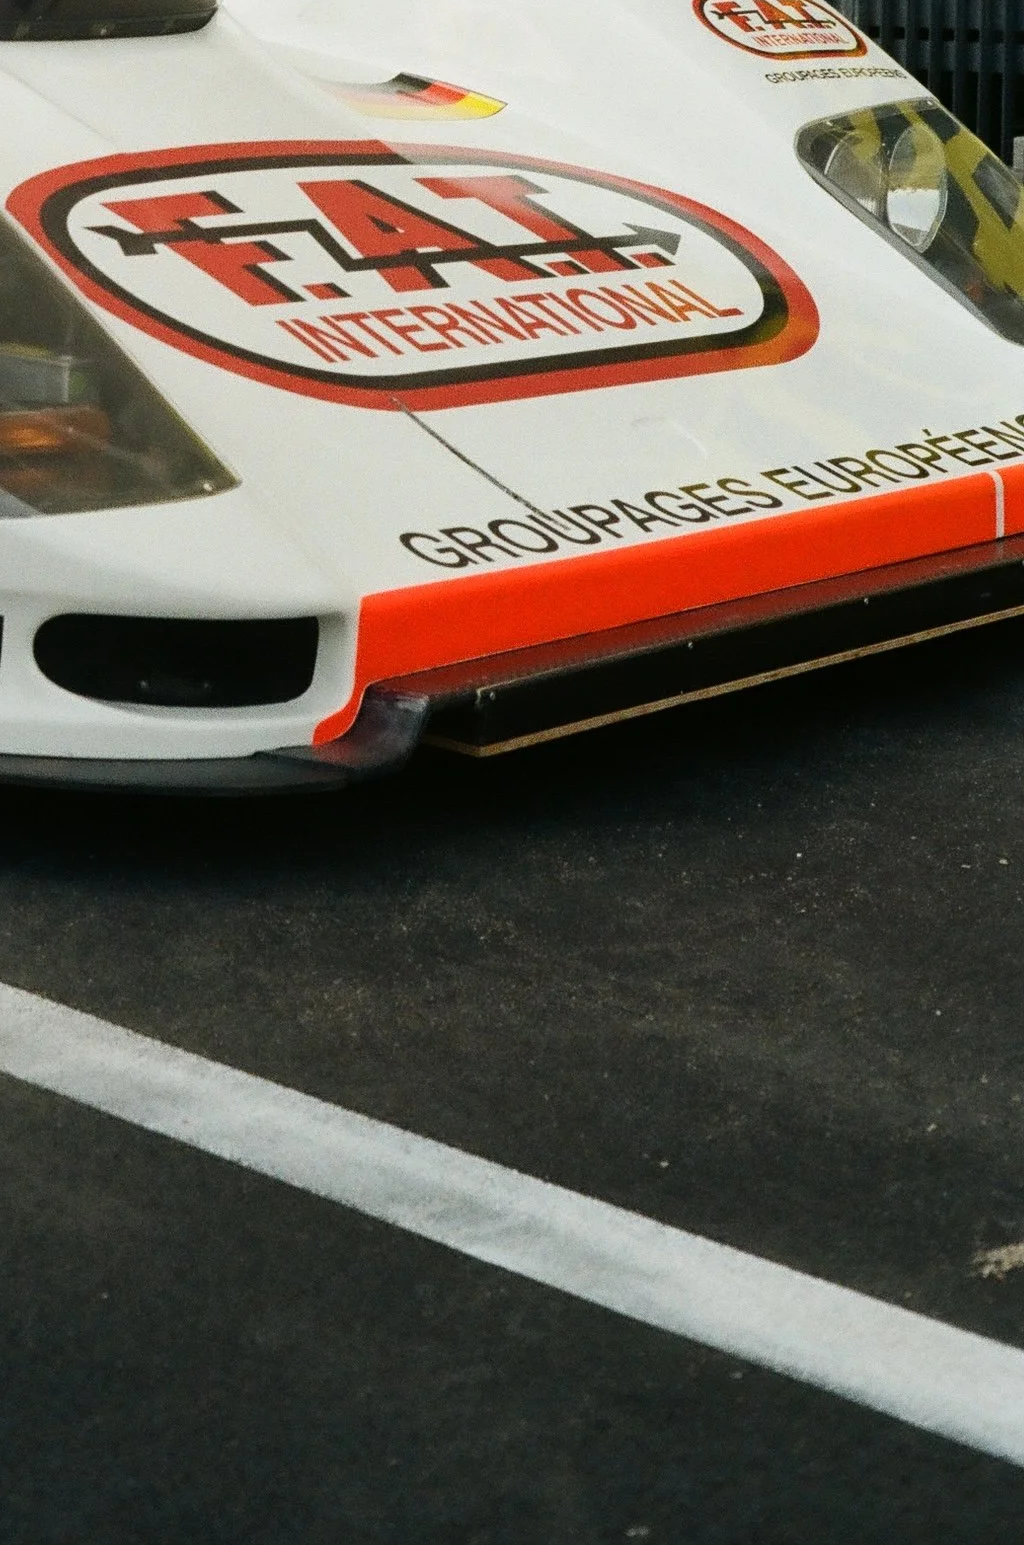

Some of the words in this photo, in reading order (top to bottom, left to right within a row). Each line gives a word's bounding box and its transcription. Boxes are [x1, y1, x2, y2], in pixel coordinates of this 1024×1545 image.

[753, 32, 849, 48] INTERNATIONAL
[765, 67, 841, 84] GROUPAGES
[275, 279, 742, 364] INTERNATIONAL
[398, 475, 783, 569] GROUPAGES
[760, 414, 1024, 502] EUROPÉEN
